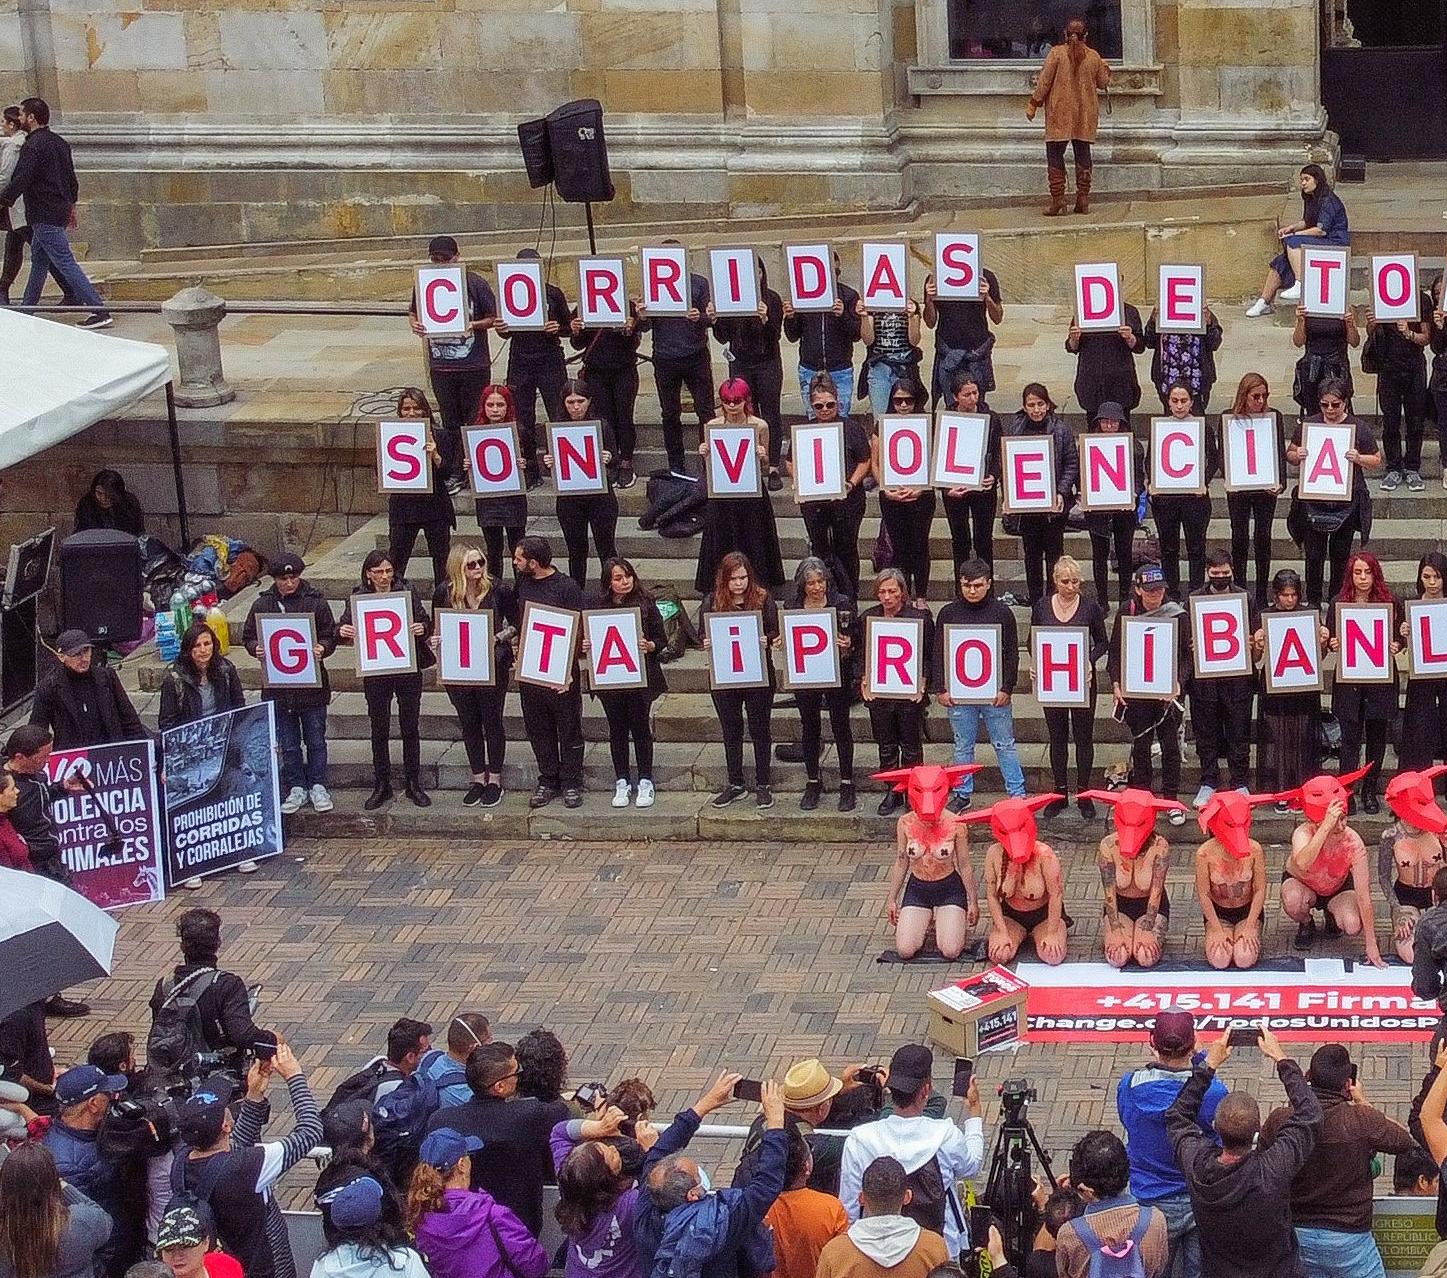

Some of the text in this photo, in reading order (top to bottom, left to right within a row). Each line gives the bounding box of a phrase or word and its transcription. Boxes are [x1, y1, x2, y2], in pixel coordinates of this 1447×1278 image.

[425, 243, 974, 324] CORRIDAS
[1081, 276, 1197, 323] DE
[387, 434, 597, 482] SON
[715, 426, 1342, 500] VIOLENCIA
[270, 610, 637, 675] GRITA
[96, 756, 143, 786] MÁS
[48, 787, 146, 825] OLENCIA
[174, 792, 262, 834] PROHIBICIÓN DE
[59, 823, 109, 844] ntra
[175, 810, 264, 849] CORRIDAS
[176, 827, 265, 870] Y CORRALEJAS
[1097, 992, 1281, 1011] +415.141
